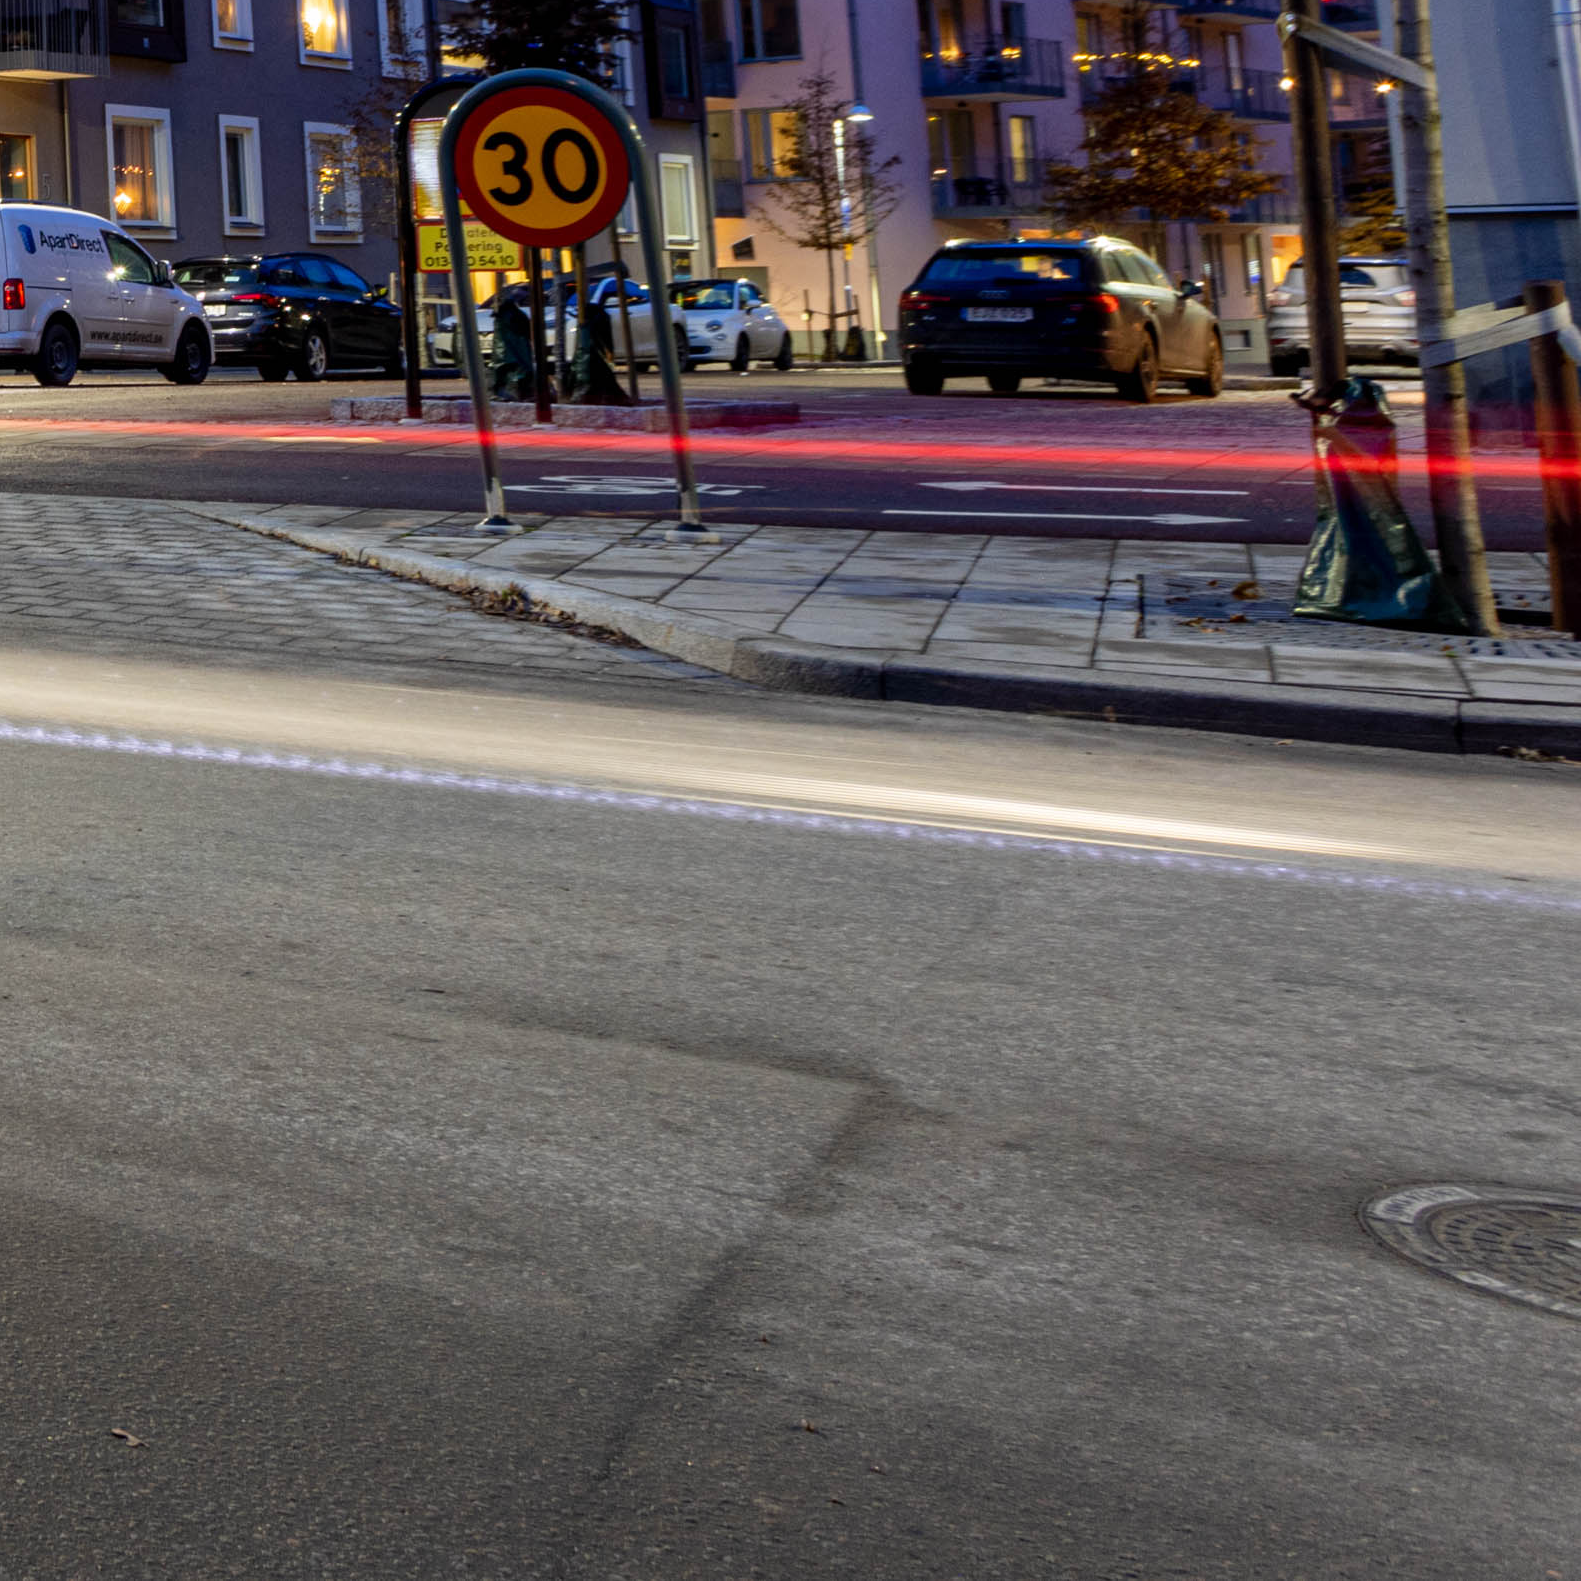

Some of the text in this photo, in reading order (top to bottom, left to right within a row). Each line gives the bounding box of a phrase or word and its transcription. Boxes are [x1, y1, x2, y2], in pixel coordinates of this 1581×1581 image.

[483, 127, 600, 206] 30
[40, 231, 104, 253] ApartDirect
[435, 241, 502, 253] Paering
[478, 256, 496, 267] 54
[500, 255, 515, 266] 10
